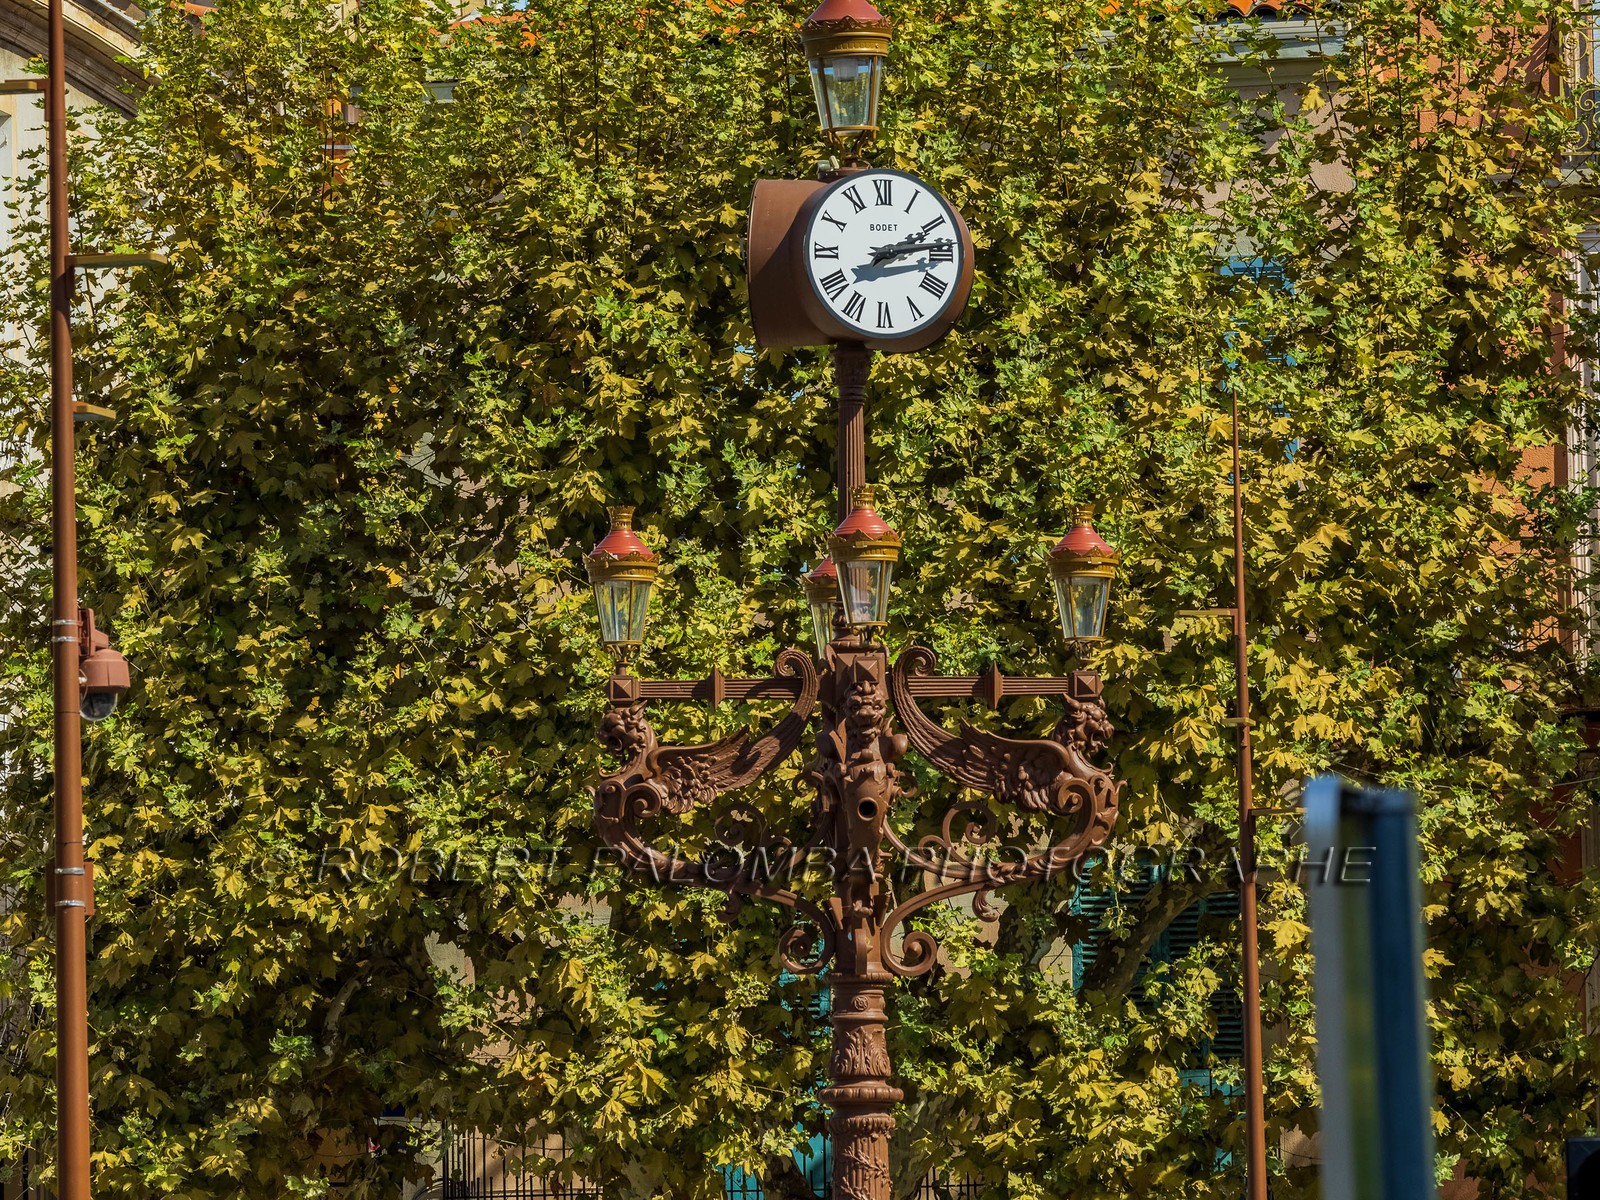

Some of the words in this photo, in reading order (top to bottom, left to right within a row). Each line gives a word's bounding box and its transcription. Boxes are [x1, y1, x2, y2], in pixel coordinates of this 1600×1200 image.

[841, 184, 867, 215] XI
[872, 179, 893, 206] XII
[821, 210, 847, 233] X
[920, 213, 946, 233] II
[814, 241, 839, 260] IX
[819, 268, 850, 303] VIII
[841, 290, 867, 323] VII
[876, 301, 894, 329] VI
[906, 296, 924, 322] V
